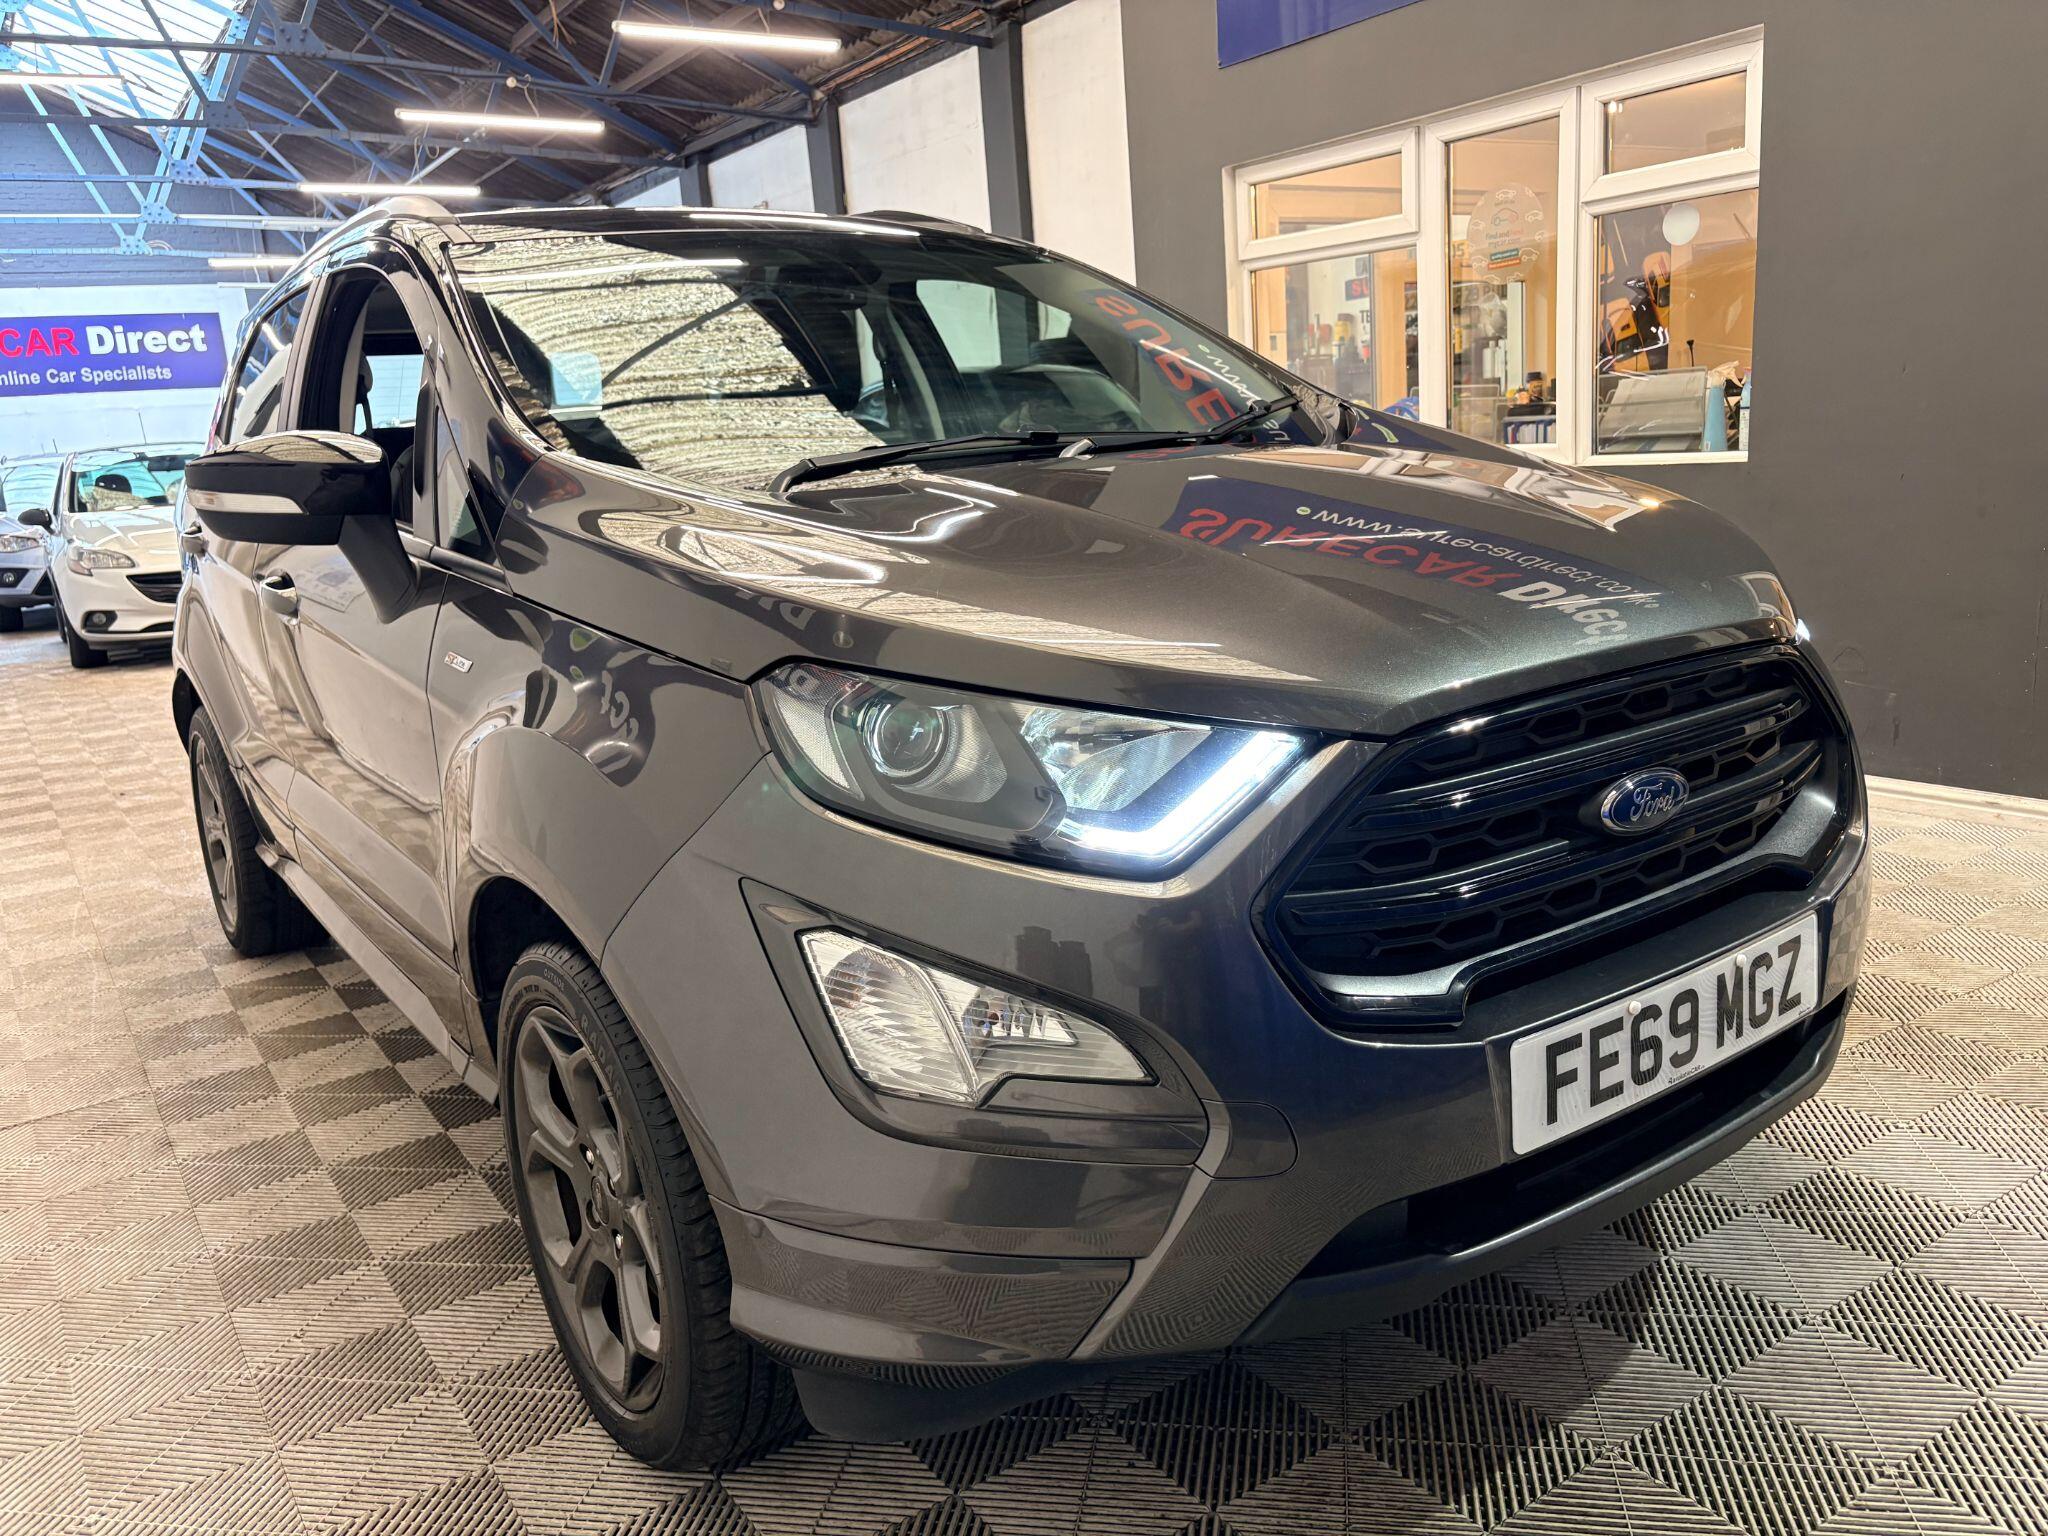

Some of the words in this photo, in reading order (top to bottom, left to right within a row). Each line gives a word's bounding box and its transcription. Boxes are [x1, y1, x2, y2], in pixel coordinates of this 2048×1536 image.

[0, 327, 80, 358] CAR
[85, 323, 208, 356] Direct
[46, 368, 76, 384] Car
[80, 365, 173, 386] Specialists
[1629, 782, 1676, 822] Ford
[1546, 988, 1700, 1126] FE69
[1716, 934, 1802, 1050] MGZ
[580, 1013, 624, 1102] RADAR
